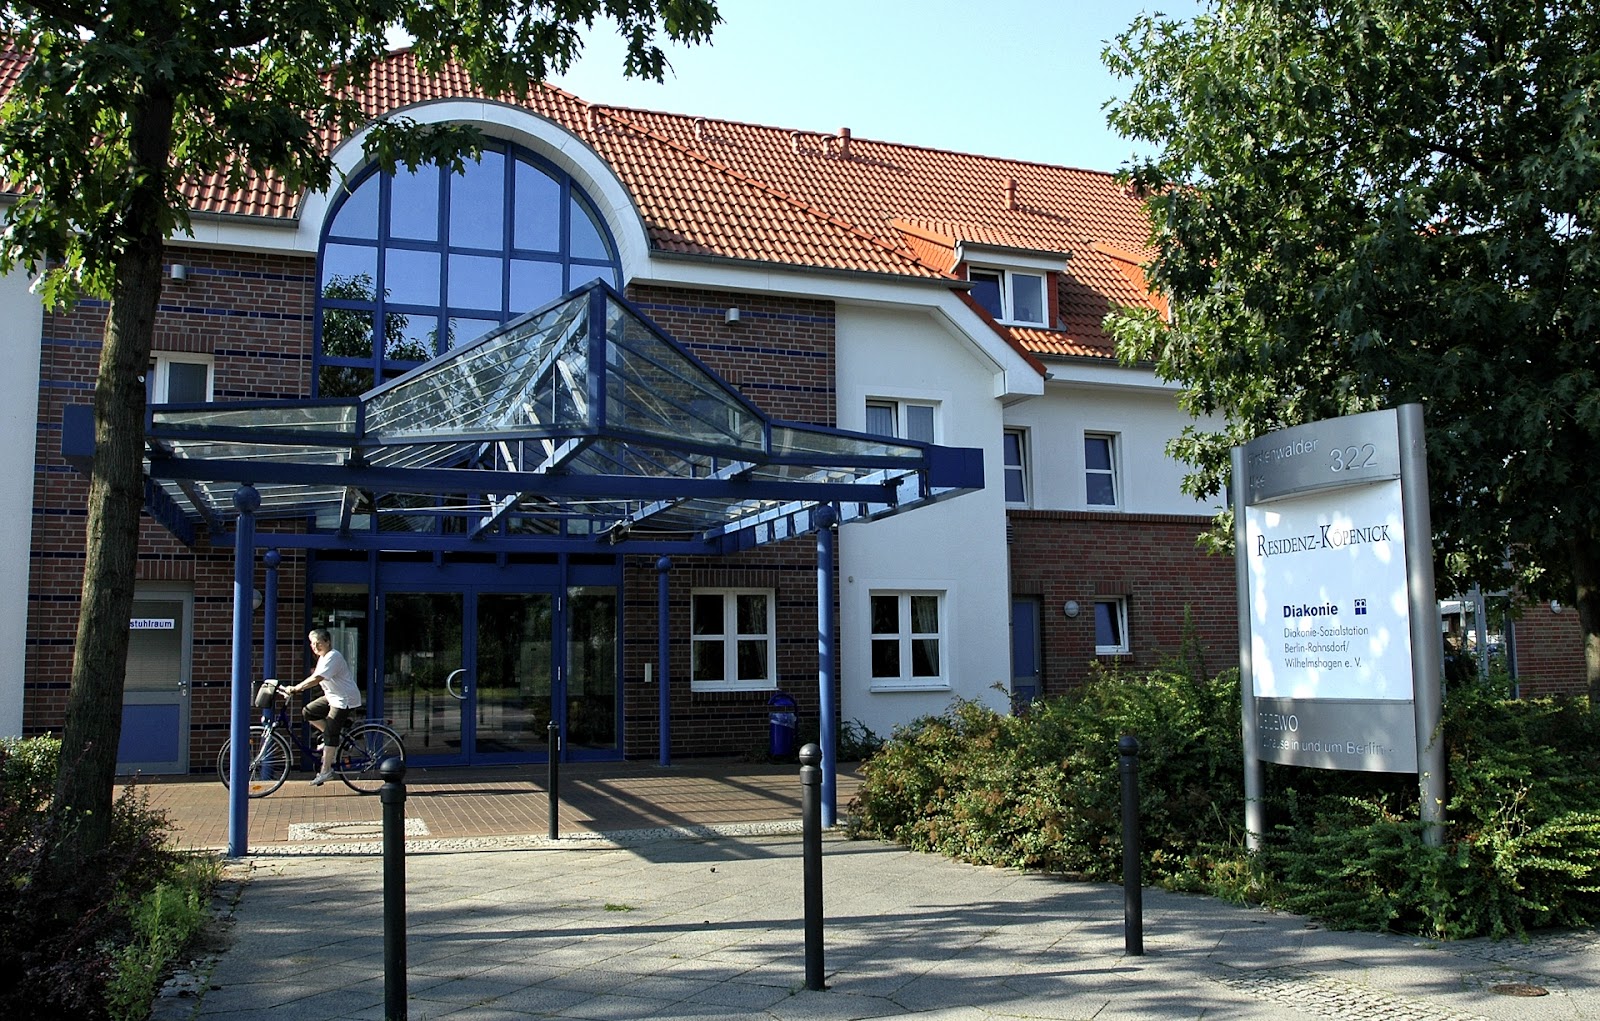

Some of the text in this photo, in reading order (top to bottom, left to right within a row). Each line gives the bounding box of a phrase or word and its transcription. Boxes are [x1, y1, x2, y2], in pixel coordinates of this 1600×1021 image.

[1329, 443, 1378, 473] 322
[1283, 602, 1338, 618] Diakonie
[130, 620, 172, 628] stuhlraum
[1283, 625, 1369, 638] Diakonie-Sozialstation
[1284, 640, 1350, 653] Berlin-Rahnsdorf/
[1284, 656, 1362, 670] Wilhelmshagen e. V.
[1291, 738, 1299, 750] in
[1302, 740, 1320, 752] und
[1324, 742, 1343, 753] um
[1346, 741, 1385, 755] Berlin
